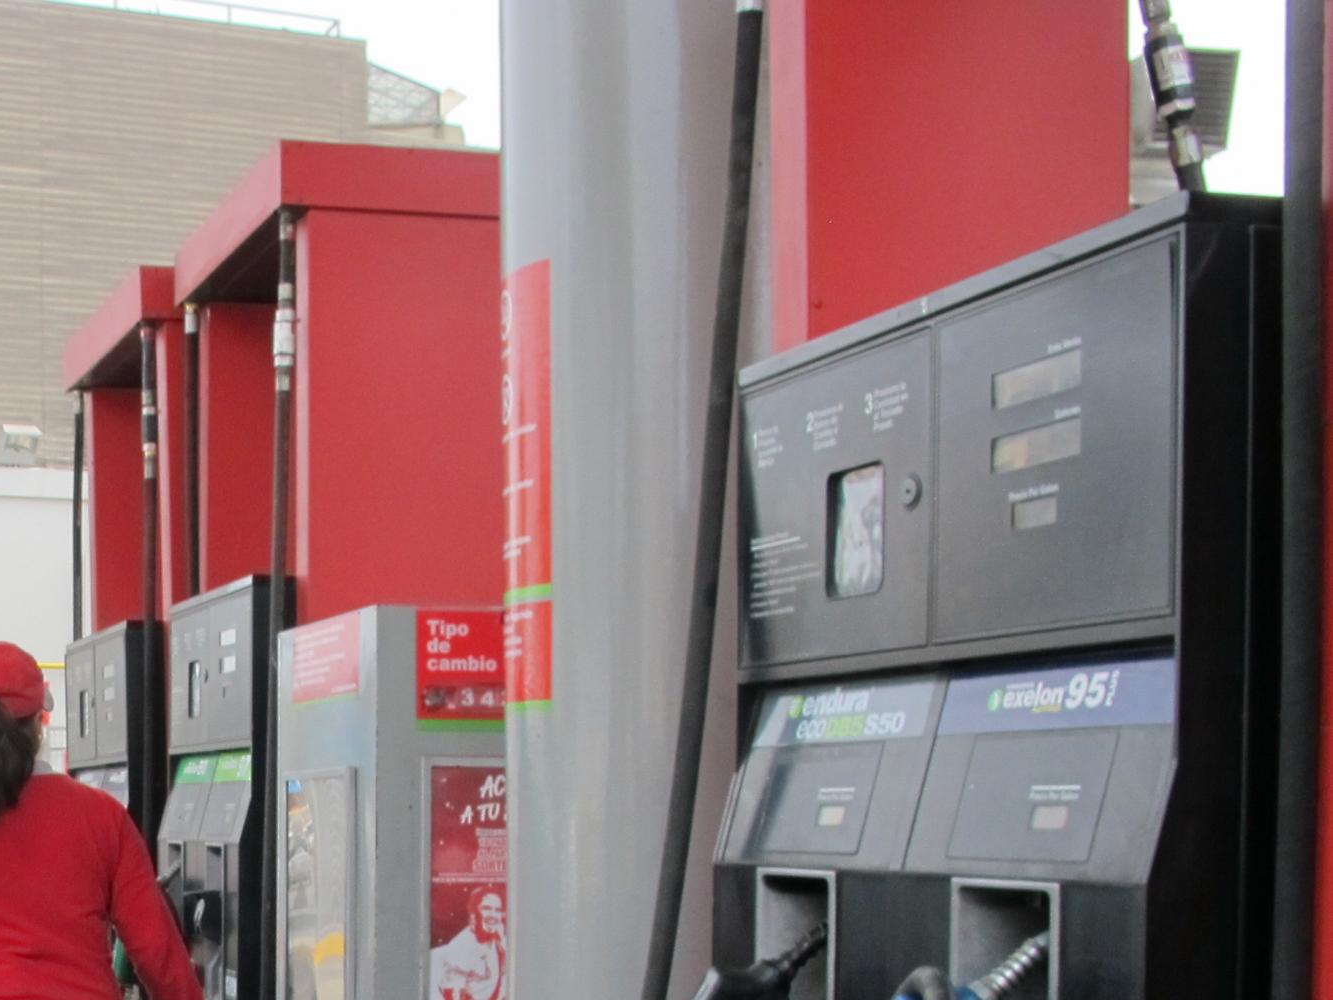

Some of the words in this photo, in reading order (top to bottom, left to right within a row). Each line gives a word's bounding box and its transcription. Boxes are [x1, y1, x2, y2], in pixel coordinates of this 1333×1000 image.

[426, 619, 469, 640] Tipo
[426, 637, 451, 654] de
[426, 654, 498, 672] cambio
[802, 686, 870, 717] endura
[1065, 673, 1109, 709] 95
[460, 804, 474, 825] A
[477, 802, 500, 822] TU
